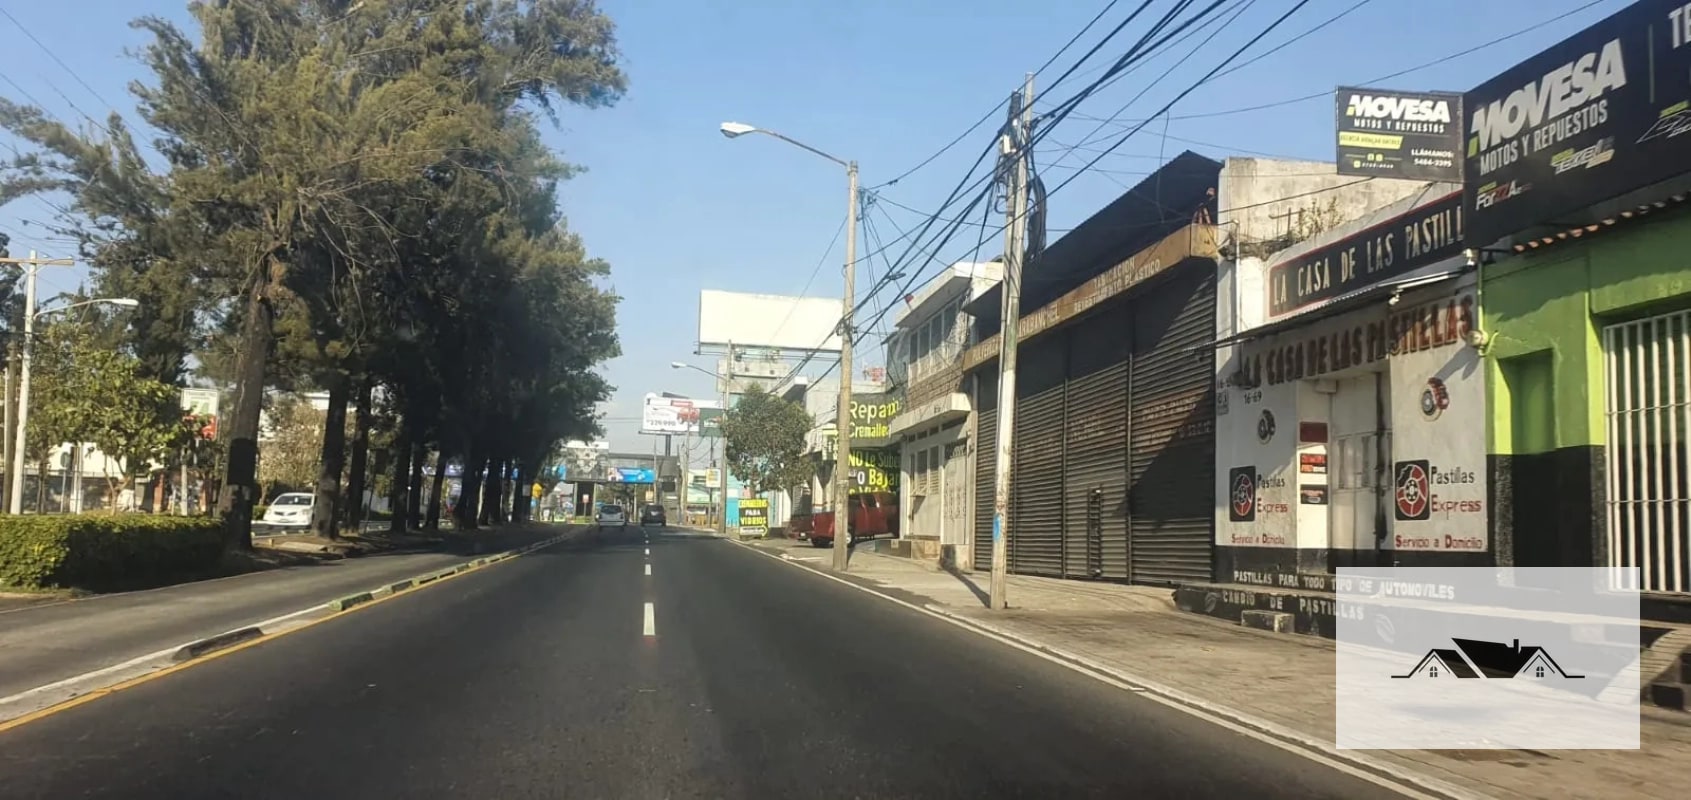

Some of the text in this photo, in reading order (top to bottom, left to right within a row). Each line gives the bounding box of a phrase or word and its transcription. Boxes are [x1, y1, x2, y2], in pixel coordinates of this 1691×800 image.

[1346, 95, 1451, 122] MOVESA
[1467, 38, 1626, 157] MOVESA
[1354, 118, 1444, 133] MOTOS Y REPUESTOS
[1480, 139, 1518, 176] MOTOS
[1522, 134, 1531, 156] Y
[1533, 100, 1608, 151] REPUESTOS
[1124, 258, 1161, 286] PLASTICO
[1274, 274, 1287, 306] LA
[1298, 258, 1330, 297] CASA
[1341, 247, 1355, 283] DE
[1367, 233, 1394, 274] LAS
[1266, 342, 1304, 386] CASA
[1307, 335, 1328, 376] DE
[1330, 325, 1363, 371] LAS
[1366, 294, 1473, 363] PASTILLAS
[1257, 475, 1286, 488] Pastillas
[1431, 466, 1475, 485] Pastillas
[1257, 498, 1288, 517] Express
[1431, 494, 1482, 520] Express
[1395, 534, 1483, 549] Servicio a Domicilio
[1233, 570, 1272, 585] PASTILLAS
[1278, 573, 1299, 587] PARA
[1304, 576, 1325, 590] TODO
[1359, 579, 1372, 593] DE
[1379, 581, 1455, 600] AUTOMOVILES
[1269, 597, 1283, 610] DE
[1300, 598, 1365, 621] PASTILLAS
